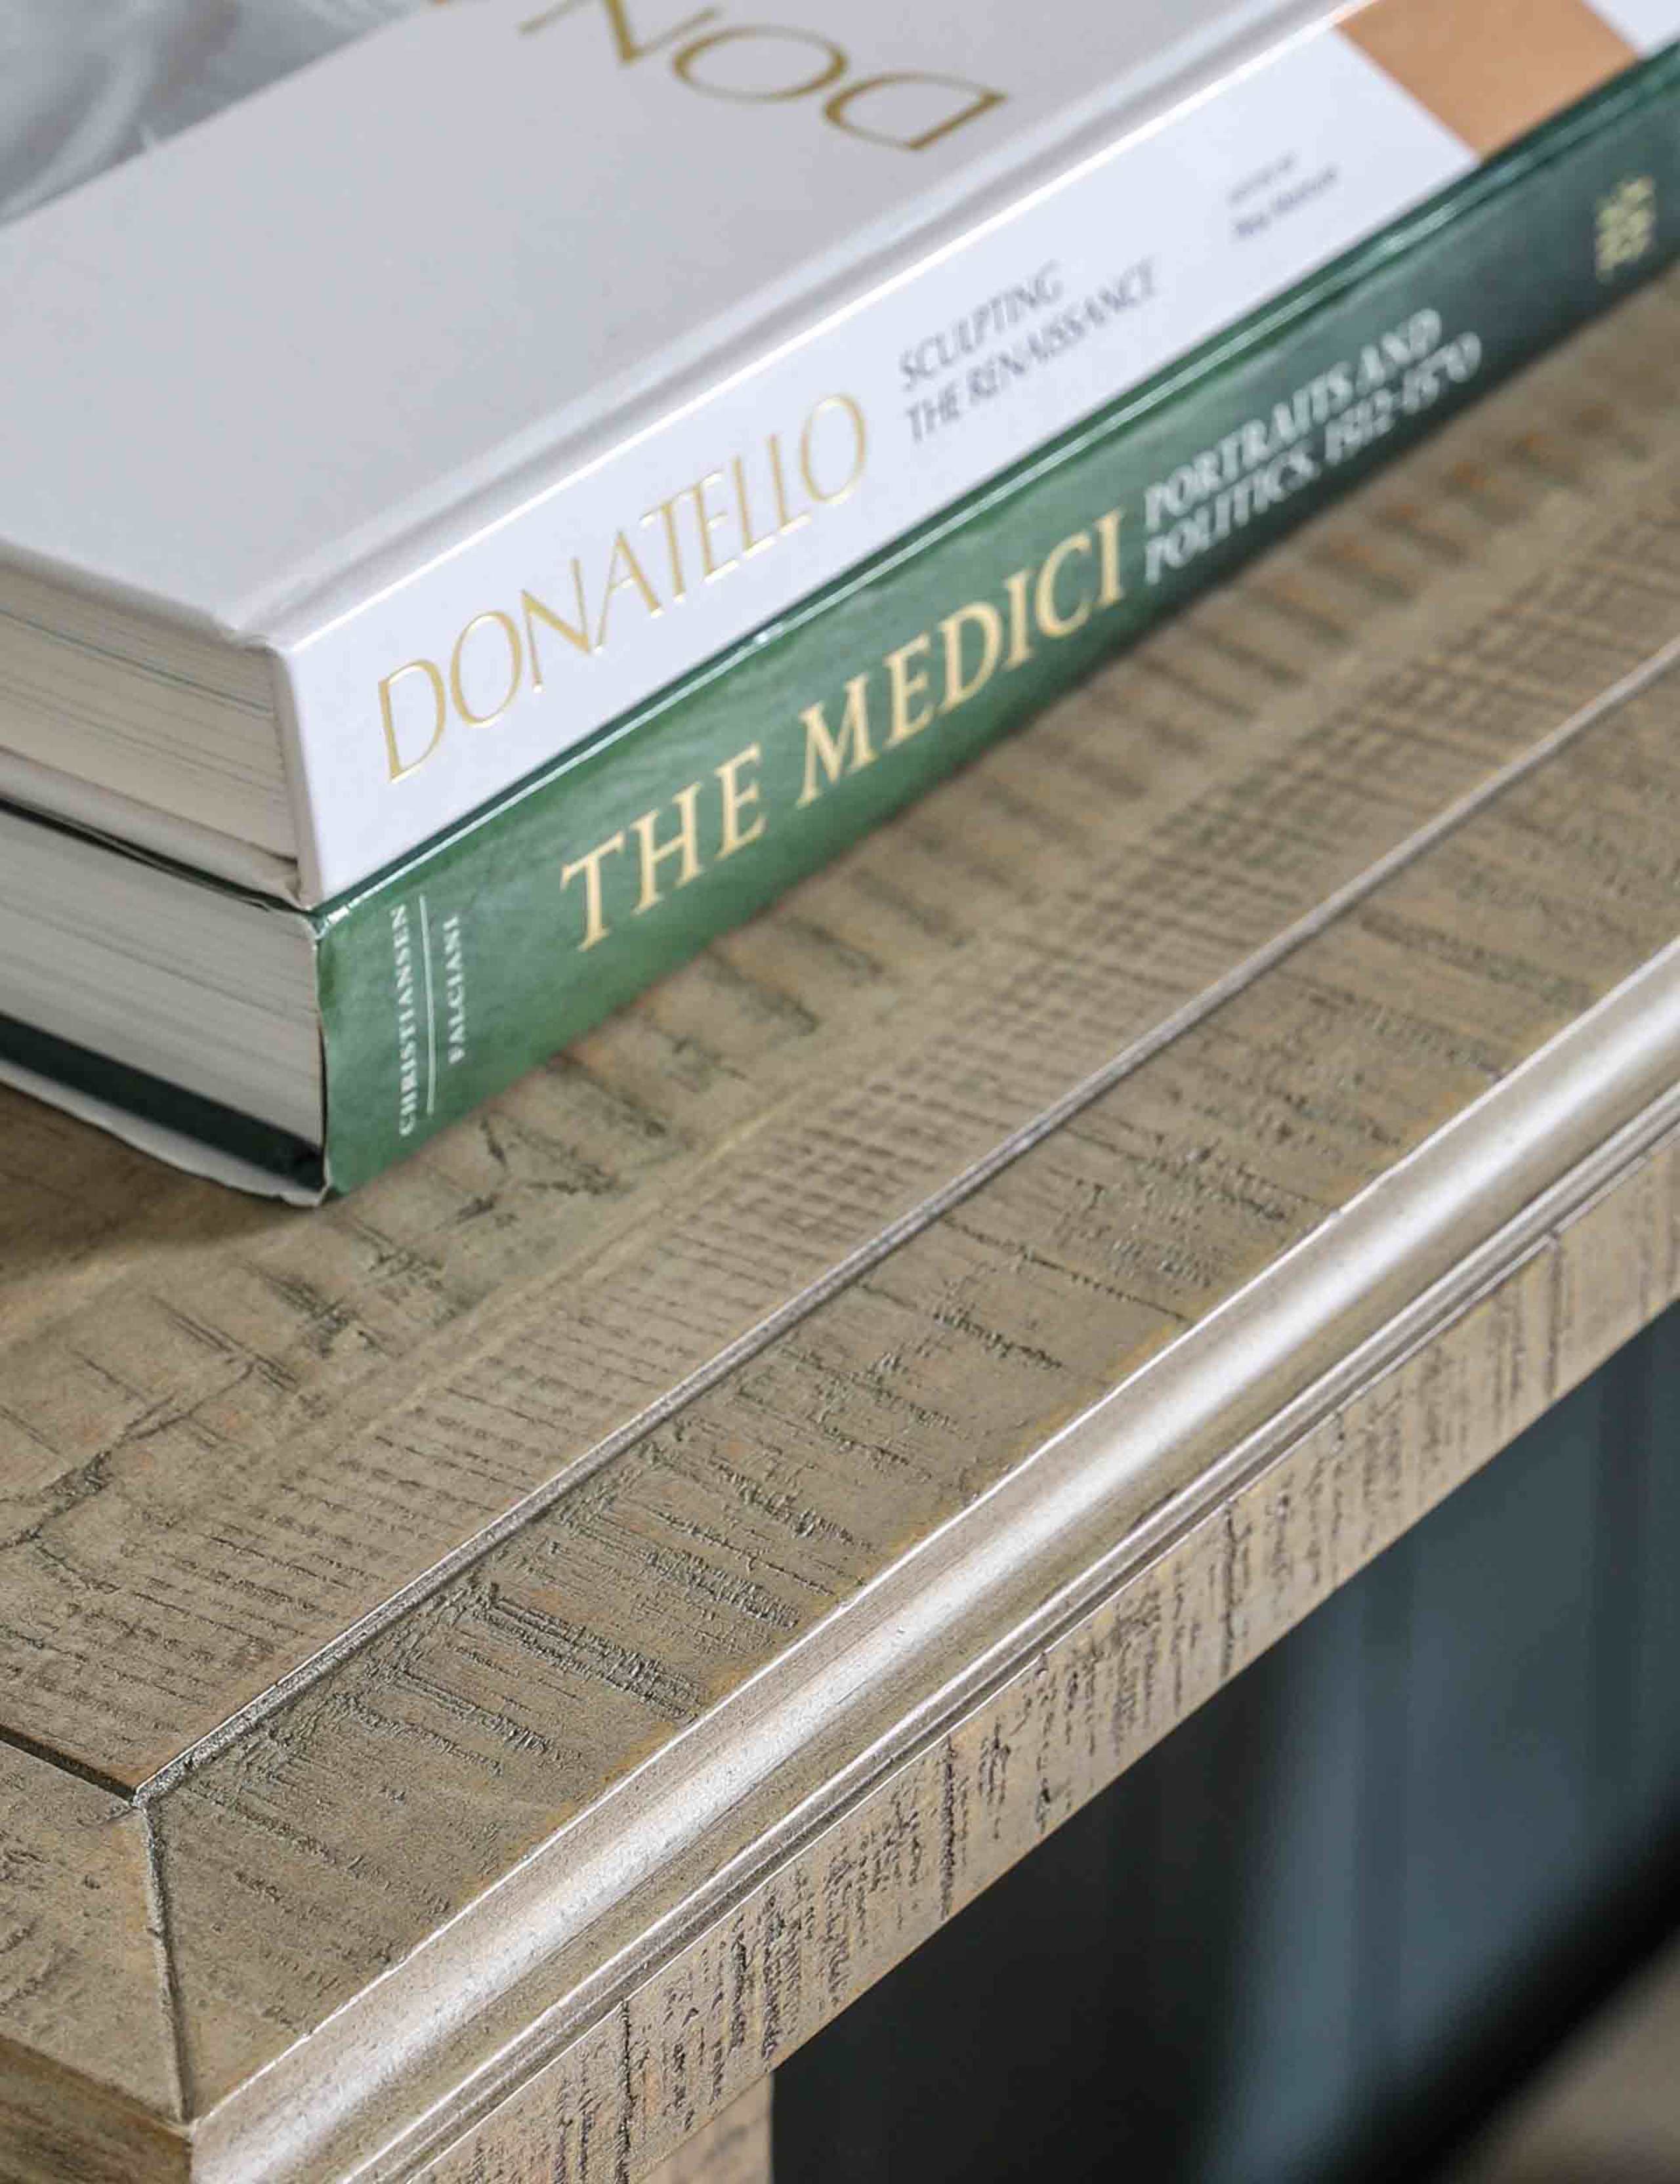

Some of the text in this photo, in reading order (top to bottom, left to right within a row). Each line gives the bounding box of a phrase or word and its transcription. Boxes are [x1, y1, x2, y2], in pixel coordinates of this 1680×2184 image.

[432, 0, 1007, 151] DON
[898, 259, 1064, 392] SCULPTING
[907, 256, 1157, 442] THE RENAISSANCE
[1144, 307, 1442, 529] PORTRAITS AND
[377, 394, 868, 783] DONATELLO
[558, 509, 1125, 952] THE MEDICI
[391, 904, 417, 1137] CHRISTIANSEN
[444, 914, 465, 1064] FALCIANI
